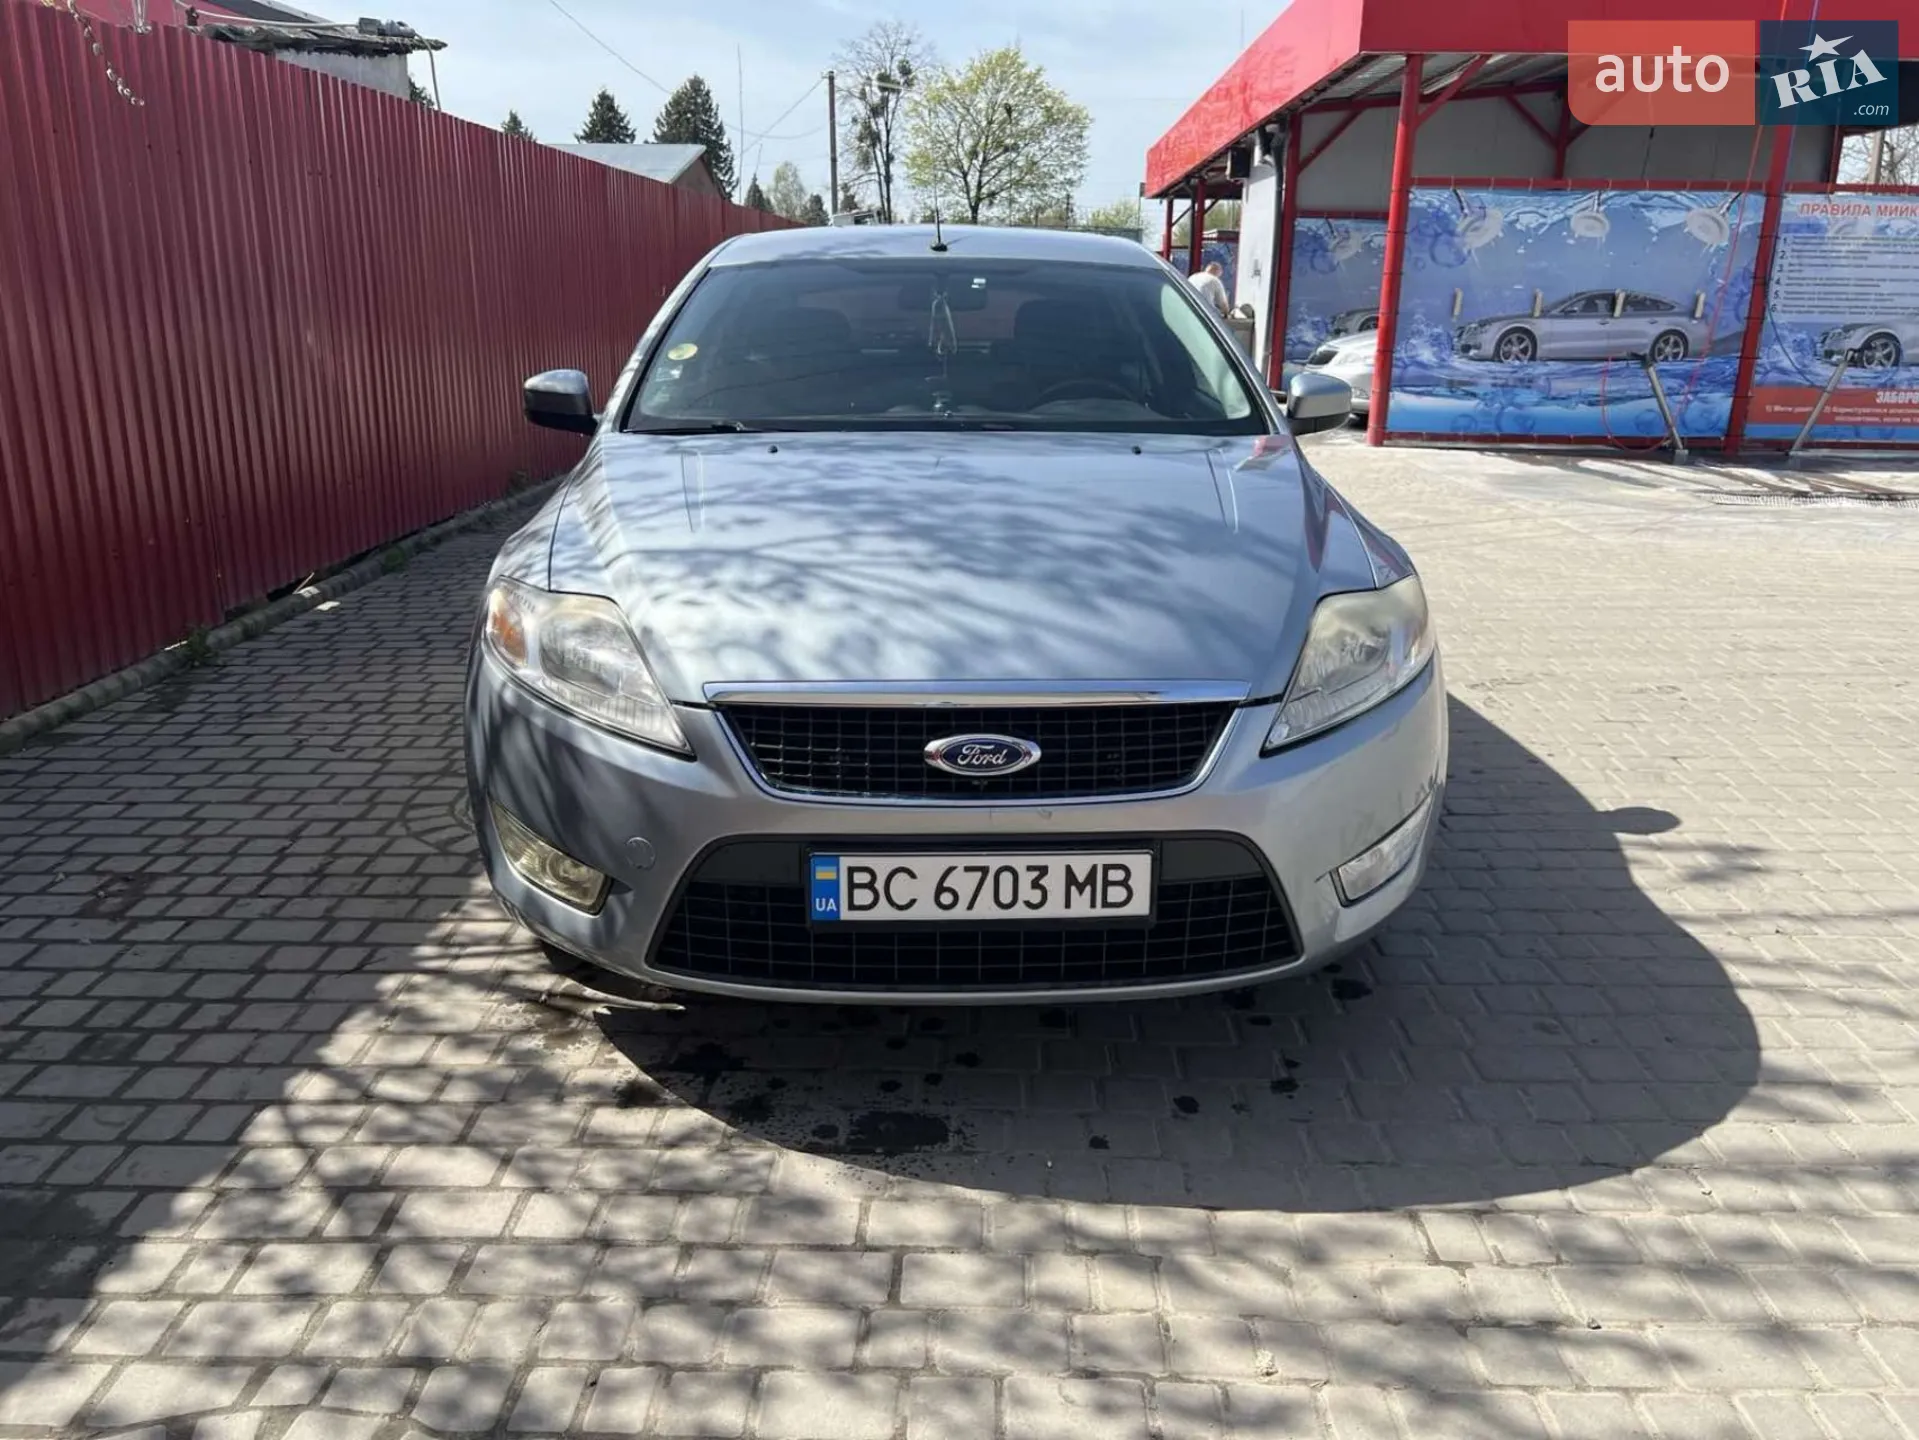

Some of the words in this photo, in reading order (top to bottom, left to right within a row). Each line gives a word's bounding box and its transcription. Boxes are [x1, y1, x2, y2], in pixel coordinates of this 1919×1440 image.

[1800, 203, 1872, 216] ПРАВИЛА
[957, 743, 1009, 766] Ford
[847, 865, 918, 912] BC
[933, 865, 1050, 911] 6703
[1064, 863, 1134, 909] MB
[815, 898, 837, 912] UA
